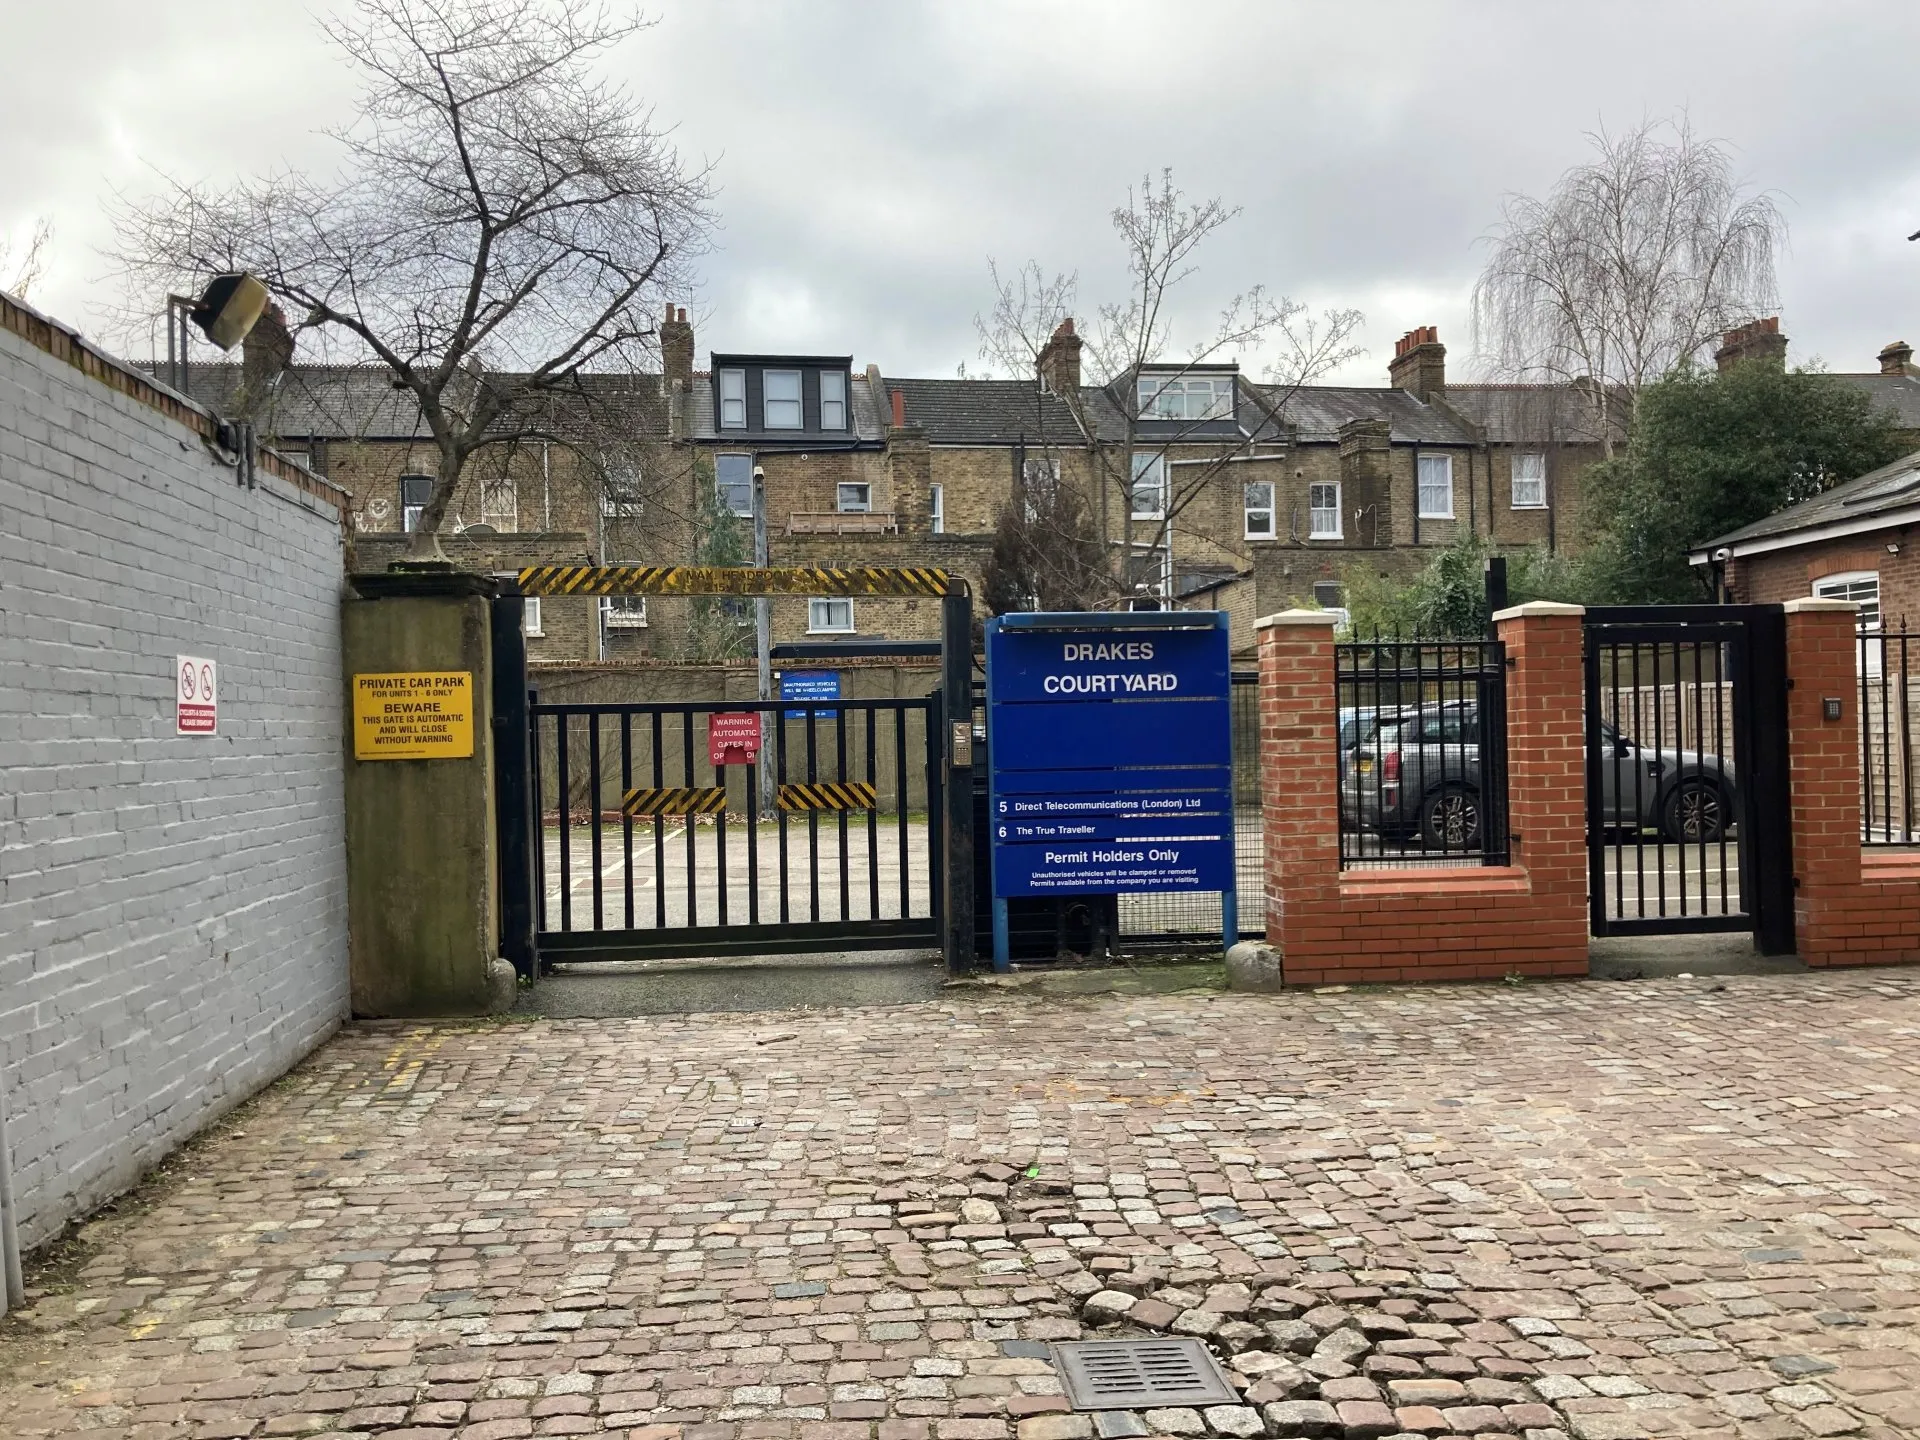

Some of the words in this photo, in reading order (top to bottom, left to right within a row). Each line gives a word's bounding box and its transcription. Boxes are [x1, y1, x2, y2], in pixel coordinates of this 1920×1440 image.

[1063, 642, 1154, 661] DRAKES
[360, 678, 406, 689] PRIVATE
[409, 677, 432, 688] CAR
[435, 677, 465, 688] PARK
[1043, 673, 1178, 694] COURTYARD
[372, 690, 388, 698] FOR
[389, 690, 412, 698] UNITS
[432, 689, 453, 697] ONLY
[384, 702, 441, 713] BEWARE
[362, 716, 381, 724] THIS
[383, 715, 405, 724] GATE
[406, 715, 415, 723] IS
[416, 714, 464, 723] AUTOMATIC
[716, 718, 753, 726] WARNING
[379, 726, 397, 734] AND
[399, 725, 419, 733] WILL
[421, 725, 448, 733] CLOSE
[713, 729, 757, 737] AUTOMATIC
[374, 736, 412, 745] WITHOUT
[414, 735, 453, 744] WARNING
[744, 740, 753, 748] IN
[999, 801, 1008, 812] 5
[1015, 802, 1042, 811] Direct
[1045, 800, 1138, 810] Telecommunications
[1141, 798, 1183, 810] (London)
[1185, 798, 1201, 807] Ltd
[998, 826, 1007, 838] 6
[1016, 827, 1033, 835] The
[1035, 826, 1056, 835] True
[1058, 825, 1096, 834] Traveller
[1045, 851, 1088, 864] Permit
[1092, 850, 1144, 863] Holders
[1148, 849, 1180, 864] Only
[1031, 871, 1076, 879] Unauthorised
[1128, 868, 1157, 877] clamped
[1148, 877, 1161, 885] you
[1175, 876, 1199, 884] visiting
